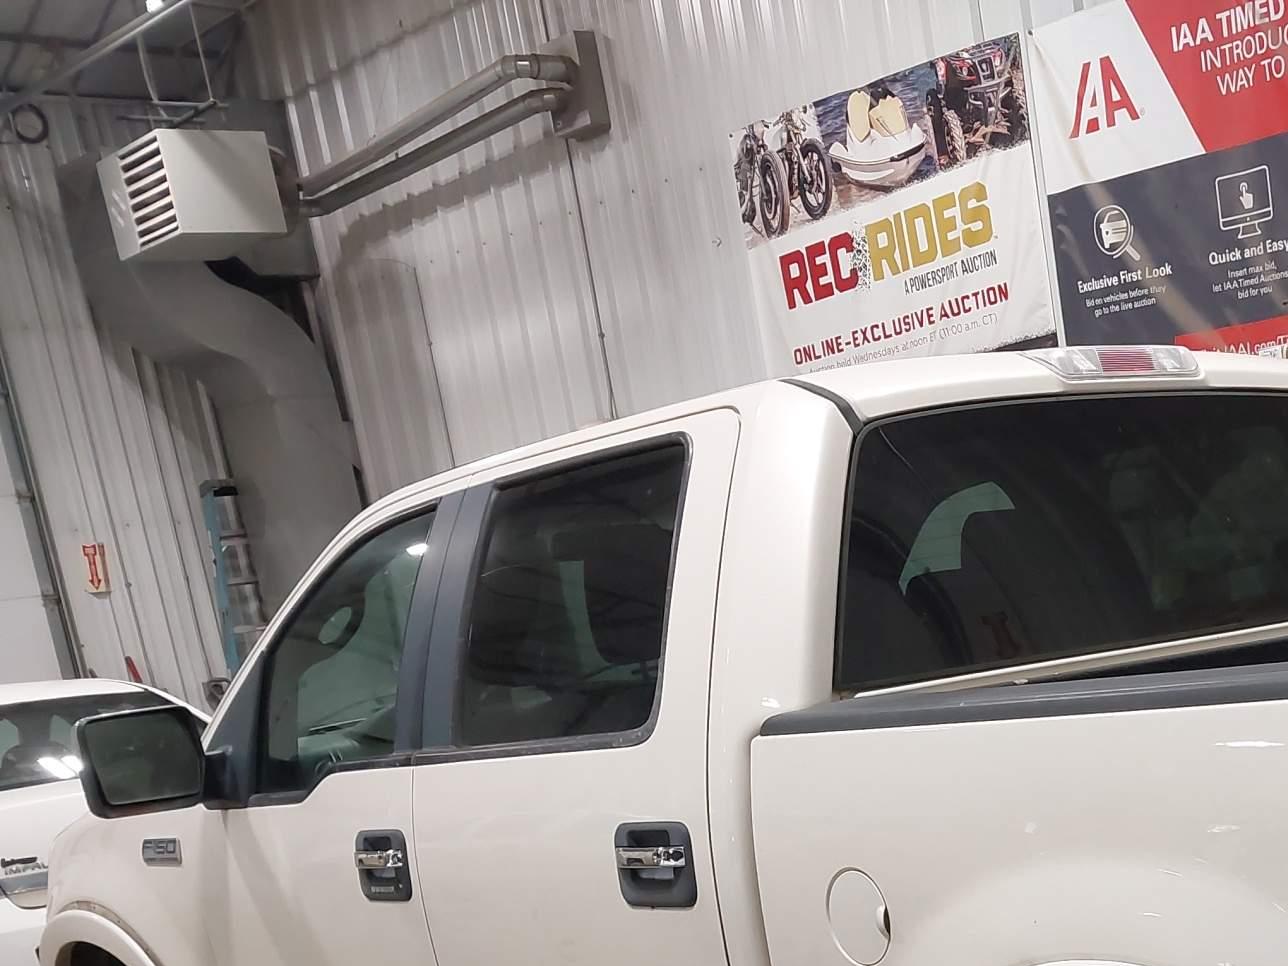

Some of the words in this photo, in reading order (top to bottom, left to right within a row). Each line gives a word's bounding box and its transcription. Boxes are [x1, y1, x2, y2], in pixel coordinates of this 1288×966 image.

[1170, 18, 1214, 52] IAA
[1216, 0, 1285, 38] TIMED
[1216, 64, 1256, 96] WAY
[1260, 56, 1285, 82] TO
[778, 231, 859, 310] REC
[865, 181, 994, 282] RIDES
[1208, 248, 1243, 266] Quick
[1243, 242, 1264, 259] and
[904, 281, 909, 296] A
[910, 262, 959, 293] POWERSPORT
[961, 250, 998, 276] AUCTION
[1077, 275, 1119, 294] Exclusive
[1119, 269, 1143, 285] First
[1145, 262, 1173, 280] Look
[1212, 283, 1222, 293] let
[1227, 267, 1248, 279] Insert
[1094, 307, 1103, 319] go
[1109, 303, 1120, 313] the
[1120, 300, 1133, 311] live
[1133, 296, 1157, 308] auction
[1103, 290, 1129, 304] vehicles
[1128, 287, 1149, 299] before
[1237, 288, 1249, 300] bid
[1249, 287, 1260, 297] for
[1260, 285, 1273, 297] you
[793, 307, 936, 366] ONLINE-EXCLUSIVE
[939, 282, 1010, 322] AUCTION
[852, 343, 900, 365] Wednesdays
[901, 341, 911, 352] at
[911, 336, 928, 350] noon
[982, 312, 999, 327] CT)
